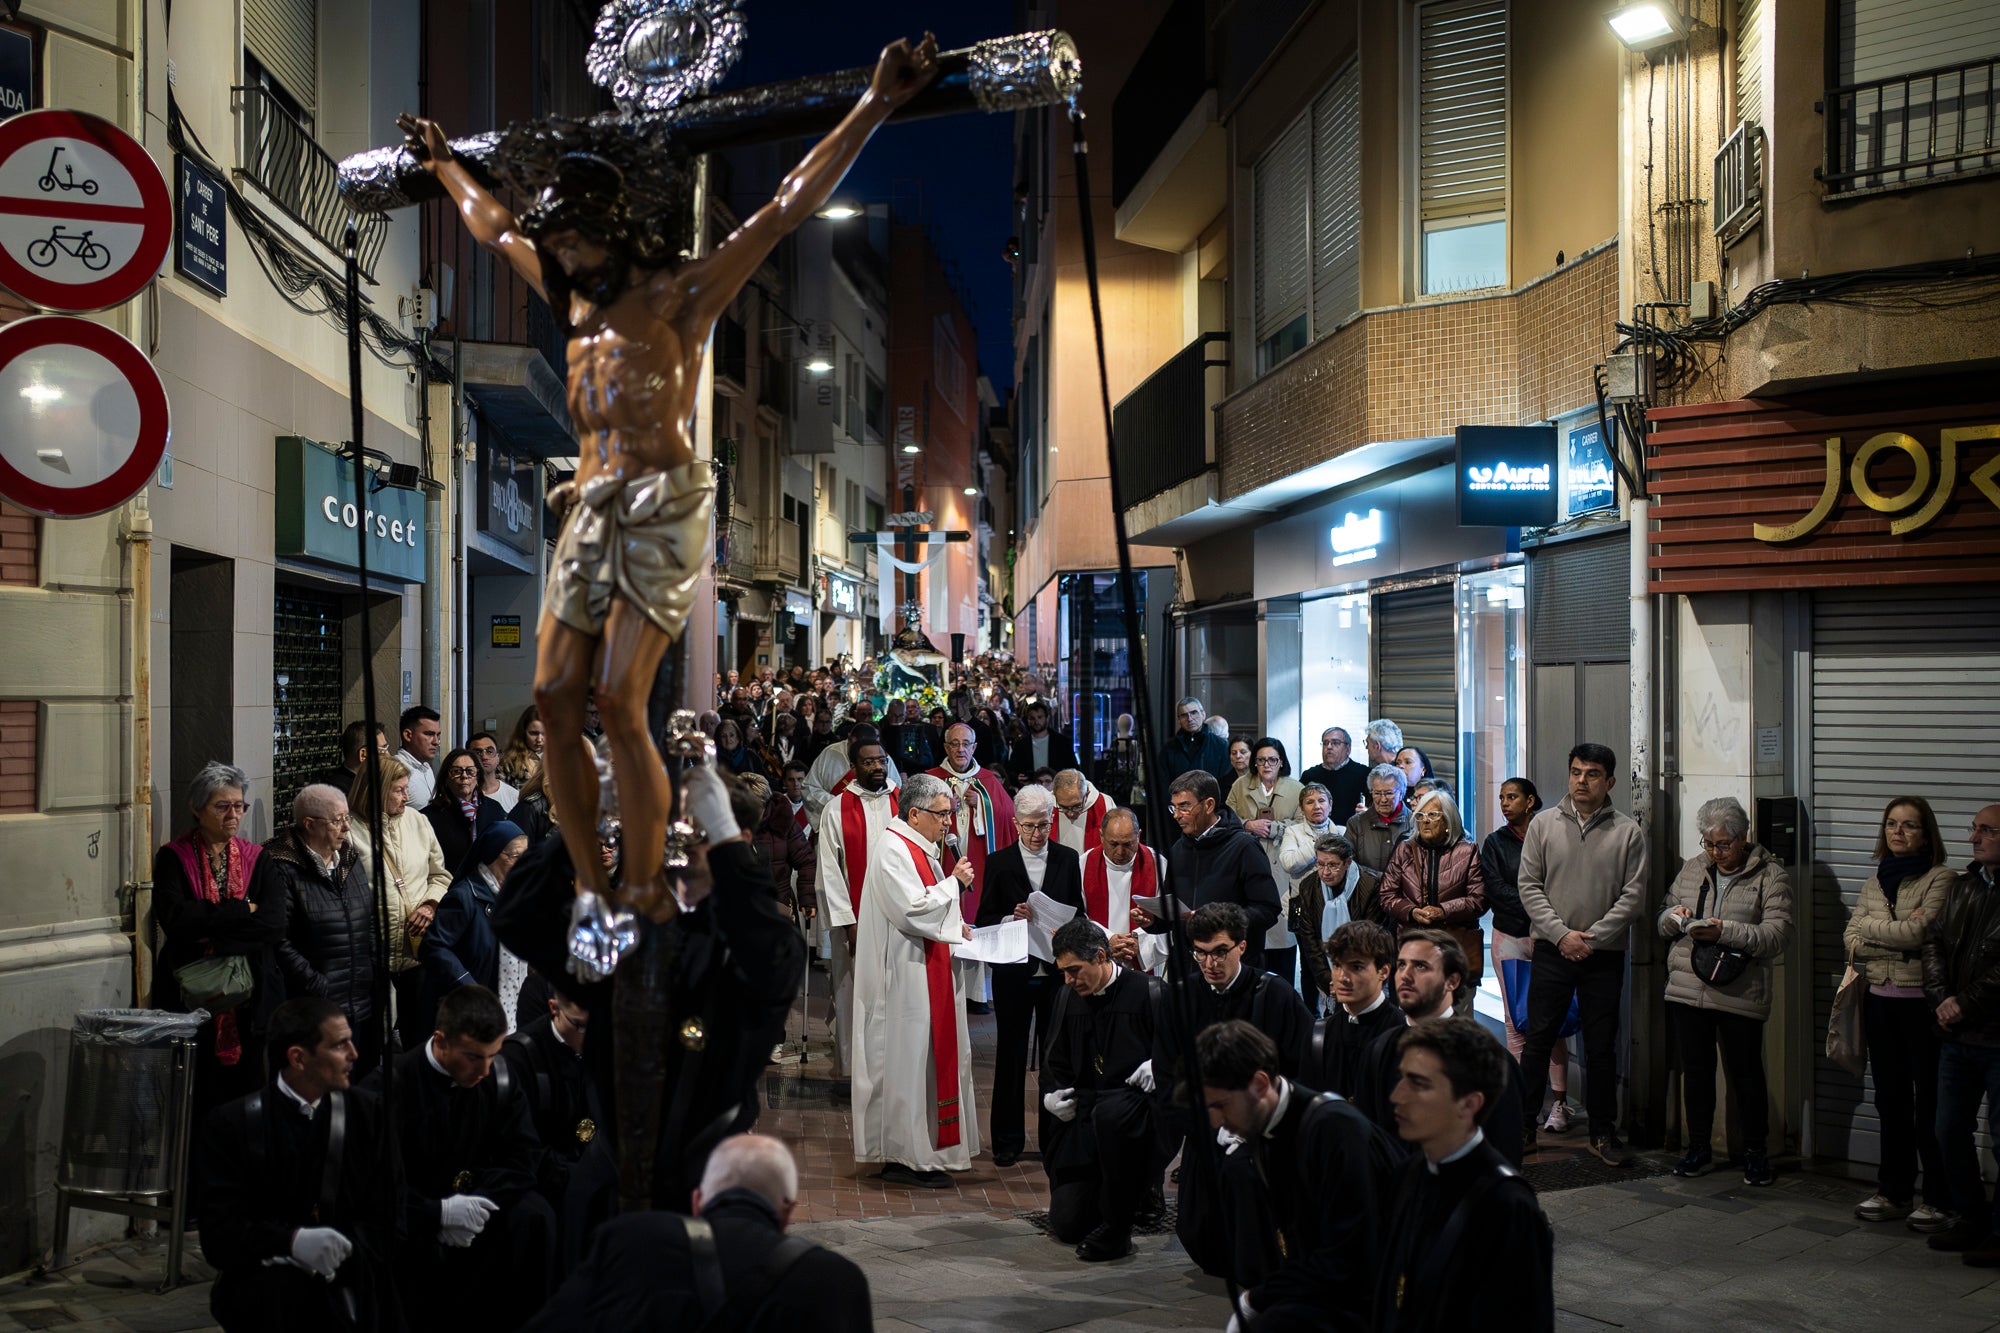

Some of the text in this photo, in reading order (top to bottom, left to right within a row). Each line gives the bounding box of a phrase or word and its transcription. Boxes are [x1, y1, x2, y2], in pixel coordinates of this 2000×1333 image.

[196, 179, 214, 203] CARRER
[202, 203, 208, 217] DE
[190, 212, 219, 246] SANT PERE
[1581, 431, 1598, 447] CARRER
[1586, 448, 1592, 458] DE
[1492, 461, 1550, 483] Aural
[324, 495, 416, 548] corset
